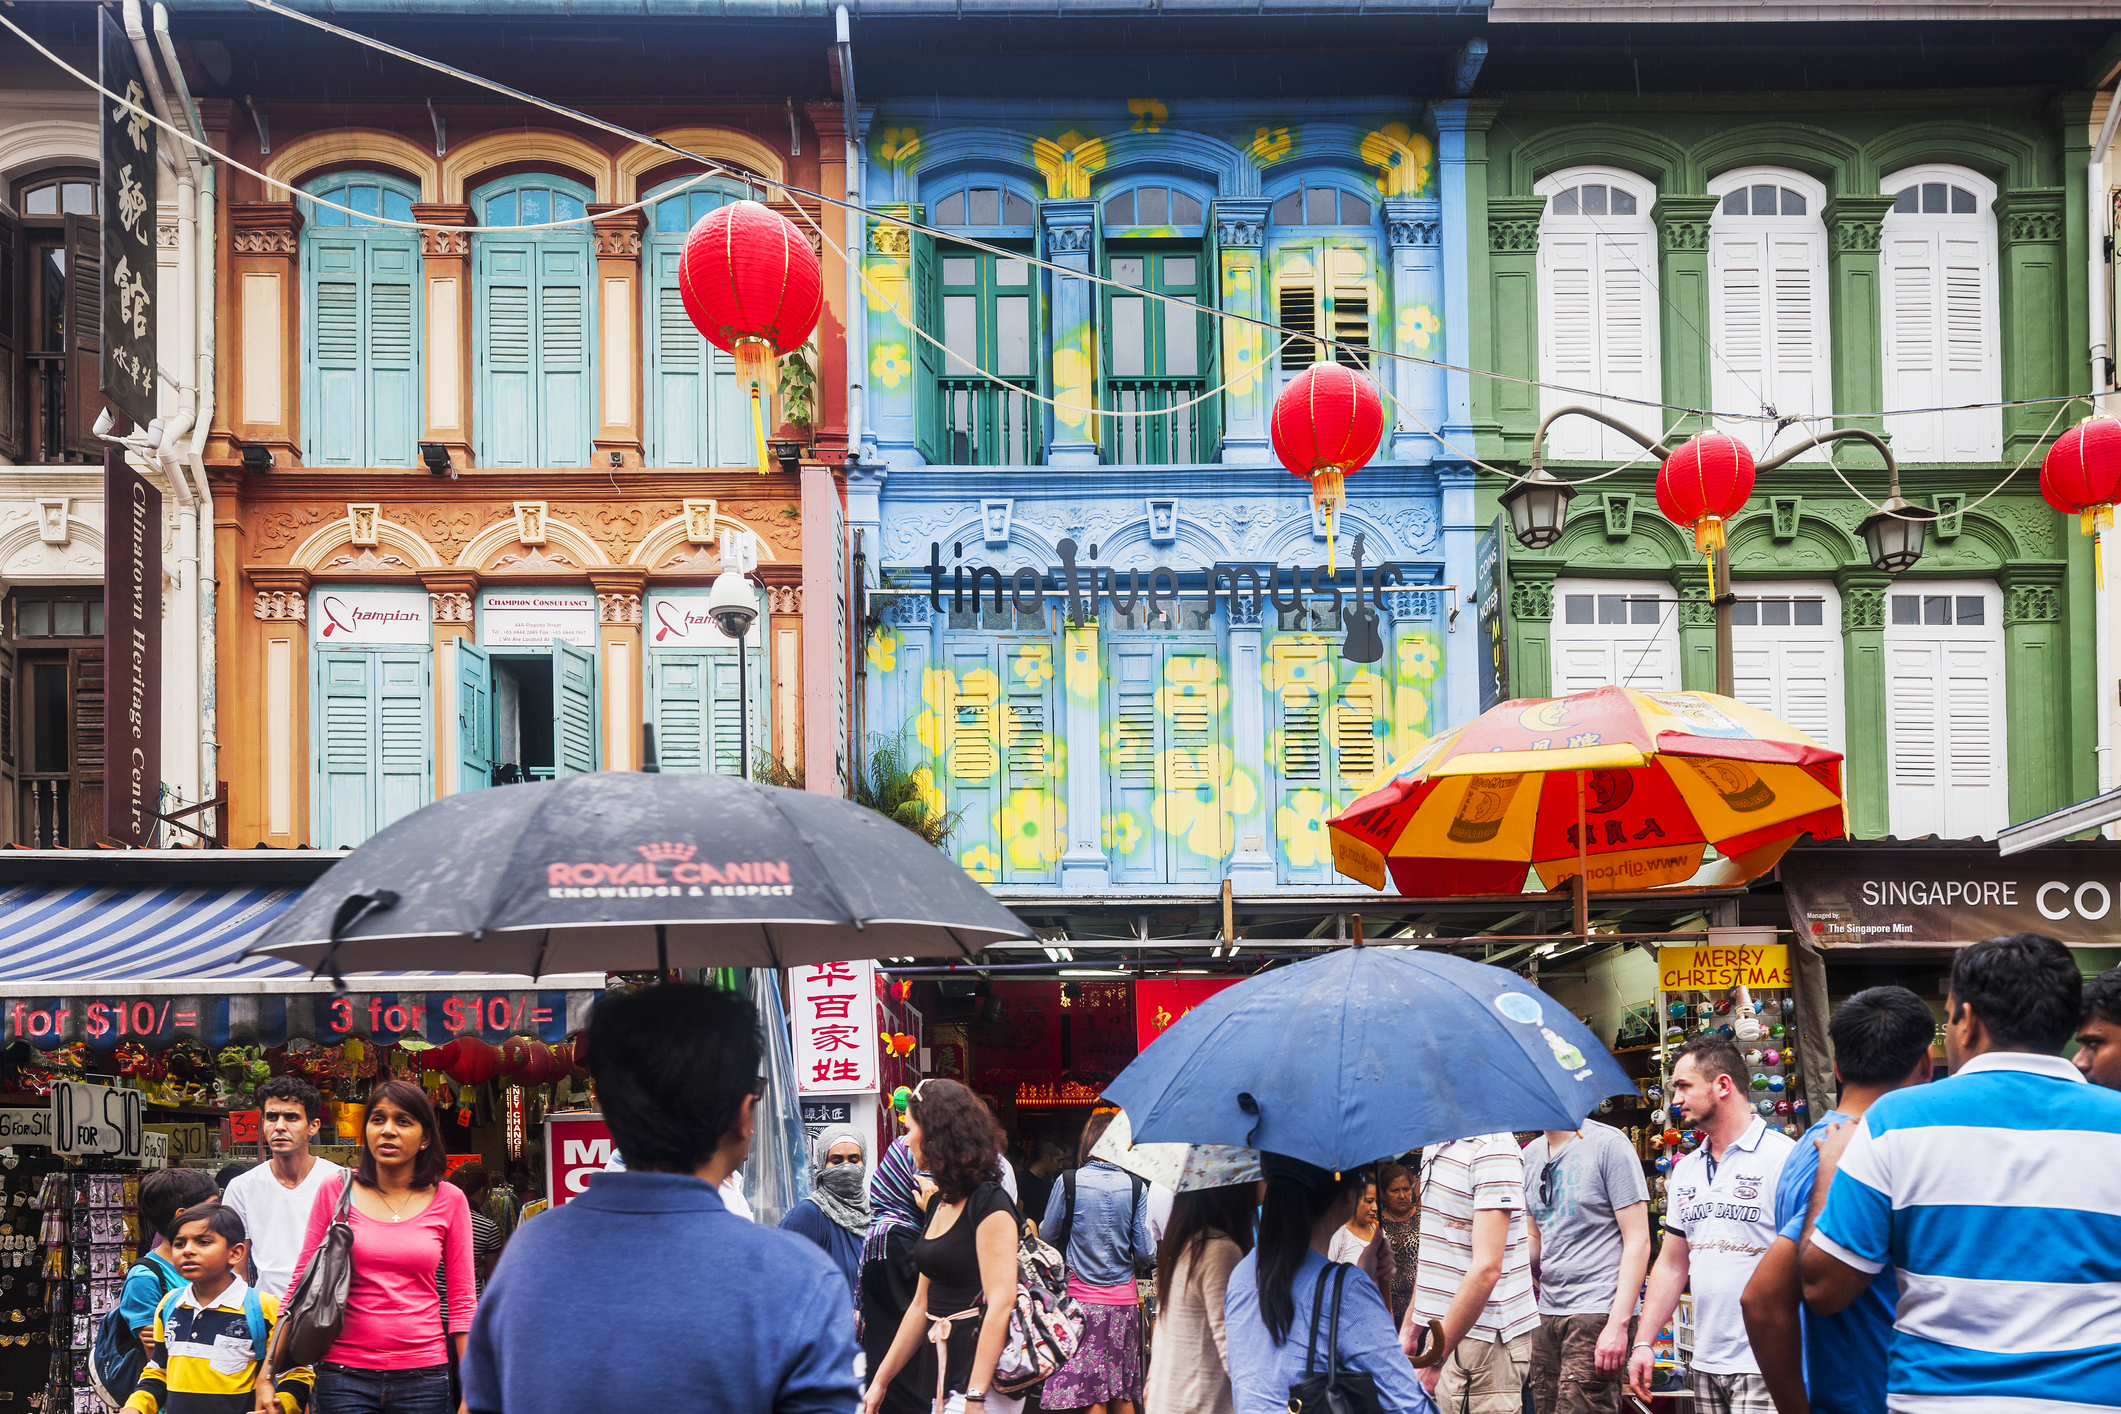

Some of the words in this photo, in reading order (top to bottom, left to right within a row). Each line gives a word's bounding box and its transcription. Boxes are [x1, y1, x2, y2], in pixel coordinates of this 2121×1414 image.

[132, 482, 146, 620] Chinatown
[1478, 529, 1497, 559] SINGAPORE
[1479, 546, 1498, 581] COINS
[1483, 580, 1493, 593] AND
[323, 596, 422, 637] Champion
[1479, 588, 1498, 623] NOTES
[129, 627, 146, 739] Heritage
[131, 747, 145, 834] Centre
[547, 861, 668, 887] ROYAL
[671, 860, 793, 885] CANIN
[548, 886, 682, 899] KNOWLEDGE
[687, 886, 705, 898] &
[709, 885, 794, 898] RESPECT
[1861, 880, 2019, 906] SINGAPORE
[2035, 880, 2121, 921] CO
[1806, 912, 1832, 920] Managed
[1832, 912, 1841, 920] by:
[1827, 923, 1845, 933] The
[1846, 923, 1891, 935] Singapore
[1892, 923, 1913, 933] Mint
[1693, 949, 1764, 967] MERRY
[1663, 966, 1793, 987] CHRISTMAS
[11, 1002, 70, 1036] for
[86, 1000, 197, 1040] $10/=
[330, 998, 353, 1033] 3
[368, 997, 428, 1032] for
[443, 995, 554, 1034] $10/=
[0, 1113, 11, 1137] 6
[12, 1121, 30, 1136] FOR
[52, 1081, 74, 1152] 10
[77, 1125, 98, 1147] FOR
[103, 1088, 142, 1157] $10
[233, 1114, 248, 1137] 3
[144, 1134, 151, 1158] 6
[172, 1127, 202, 1154] $10
[512, 1111, 522, 1159] CHANGER
[1715, 1202, 1761, 1223] DAVID
